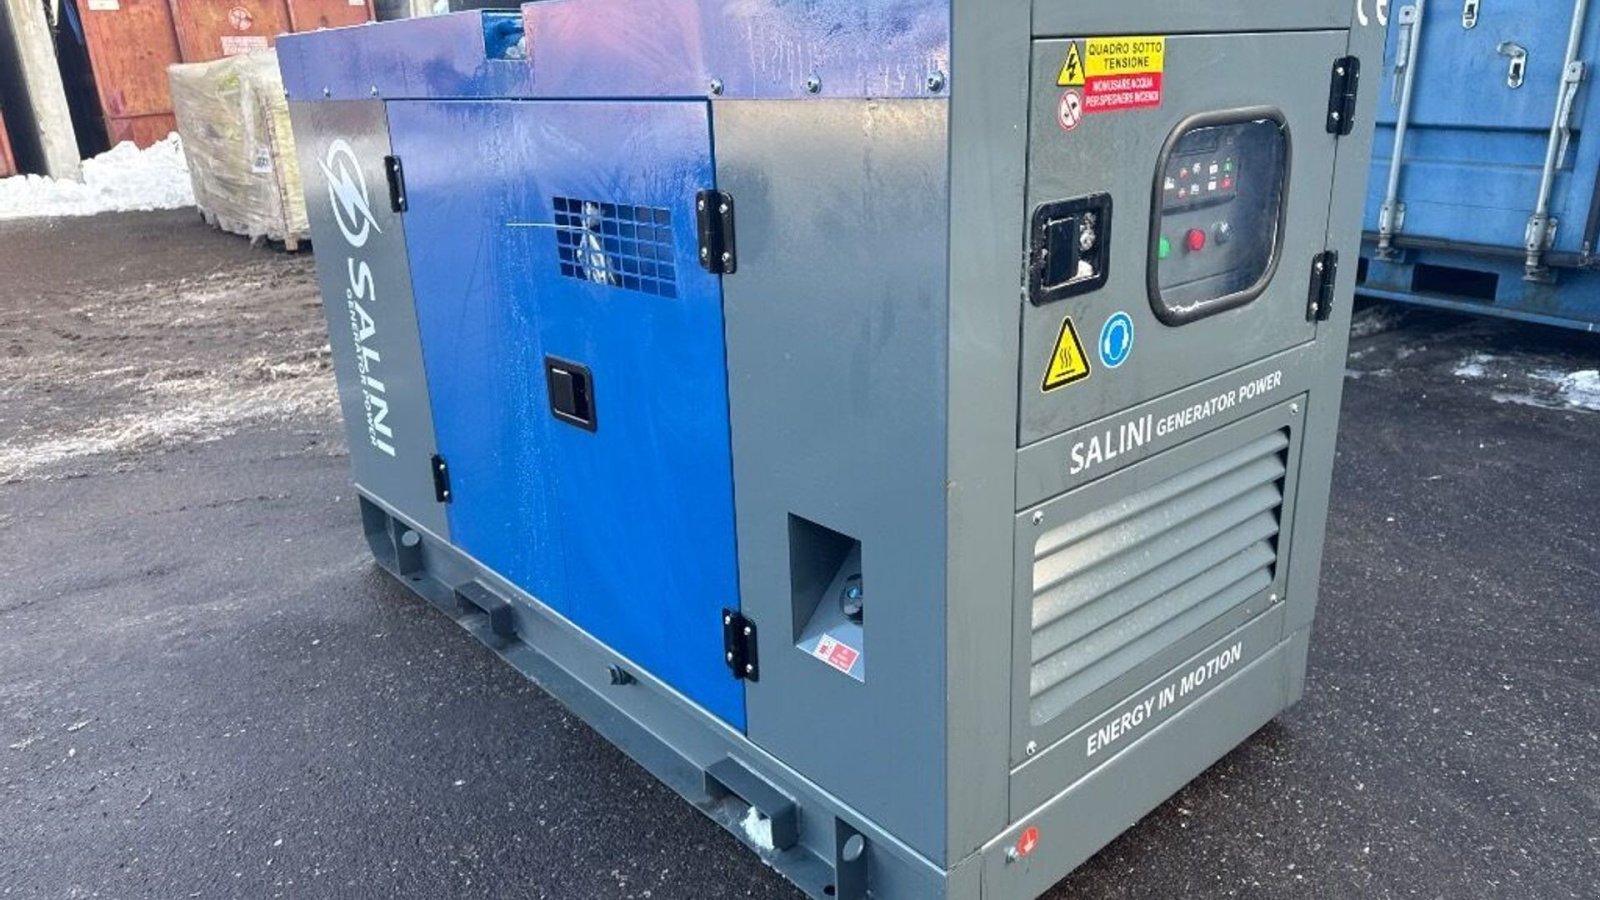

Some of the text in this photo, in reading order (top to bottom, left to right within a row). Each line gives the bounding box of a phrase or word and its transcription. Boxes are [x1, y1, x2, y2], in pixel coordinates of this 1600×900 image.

[1088, 42, 1162, 56] QUADRO SOTTO
[1104, 56, 1150, 69] TENSIONE
[346, 288, 377, 446] GENERATOR POWER
[347, 258, 396, 457] SALINI
[1070, 370, 1282, 475] SALINI GENERATOR POWER
[1087, 641, 1242, 757] ENERGY IN MOTION
